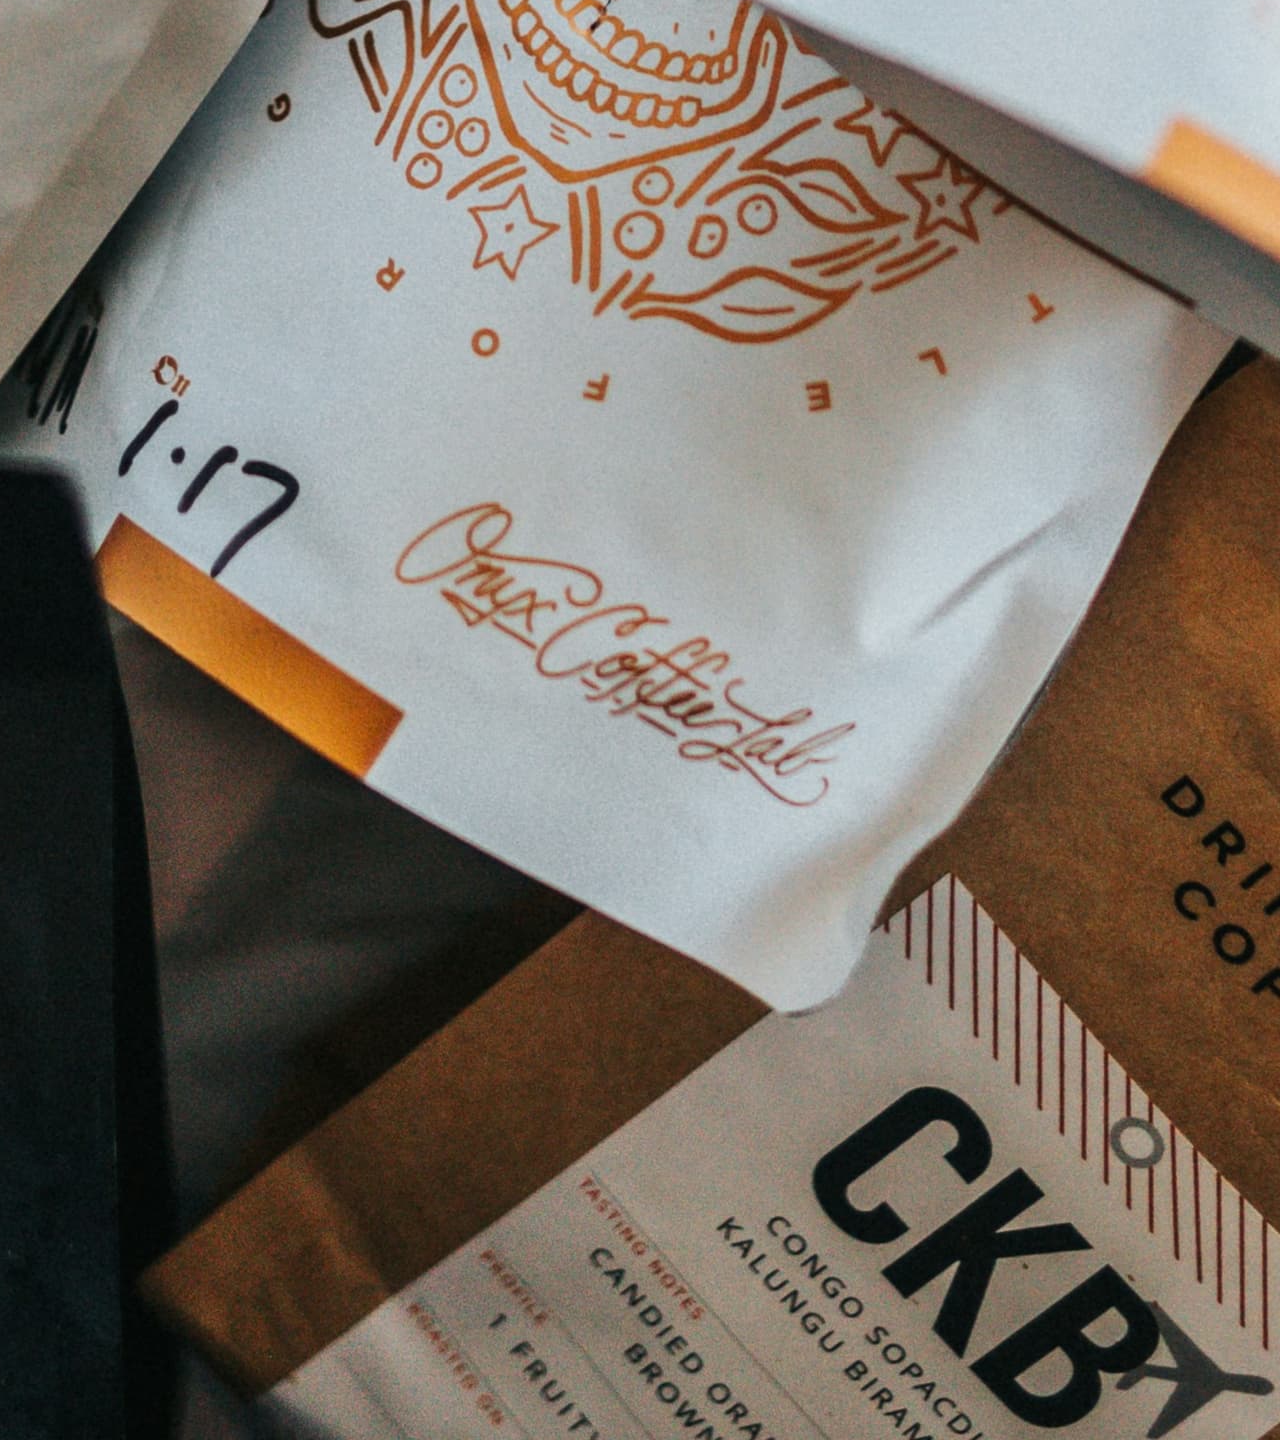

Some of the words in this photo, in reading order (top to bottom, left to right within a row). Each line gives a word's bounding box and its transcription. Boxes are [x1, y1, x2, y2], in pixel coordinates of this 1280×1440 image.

[395, 500, 603, 628] Onyx
[536, 603, 732, 738] Coffee
[677, 678, 857, 808] Lab
[716, 1216, 844, 1353] KALUNGU
[766, 1215, 865, 1319] CONGO
[812, 1086, 1160, 1430] CKB
[509, 1340, 604, 1440] FRUIT
[588, 1247, 704, 1375] CANDIED
[706, 1381, 777, 1440] ORA
